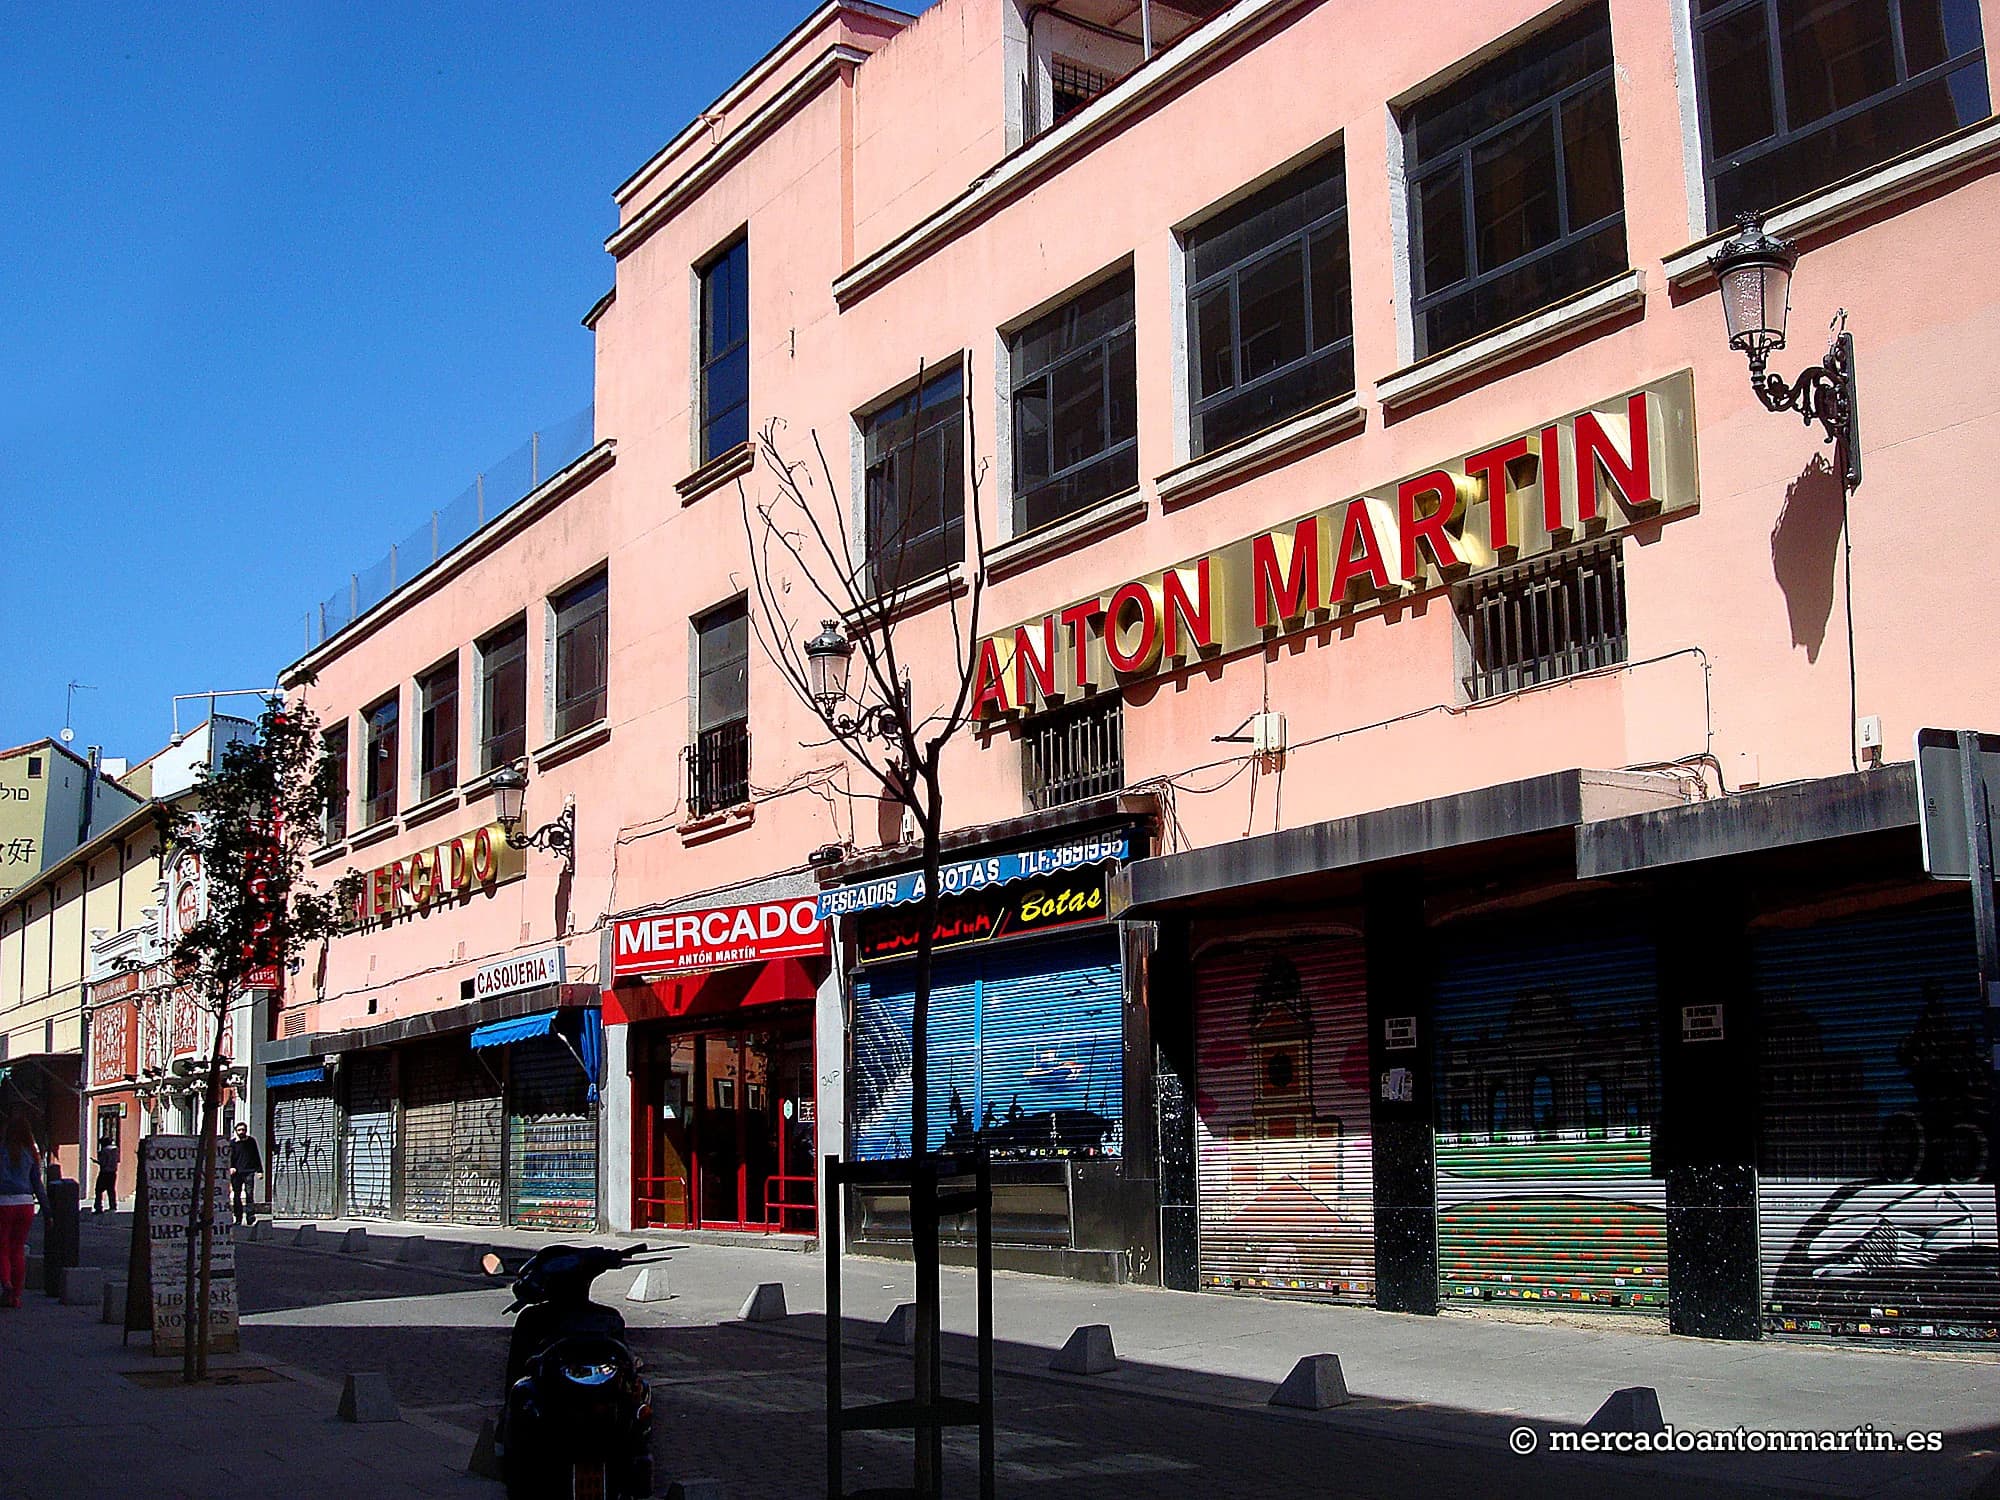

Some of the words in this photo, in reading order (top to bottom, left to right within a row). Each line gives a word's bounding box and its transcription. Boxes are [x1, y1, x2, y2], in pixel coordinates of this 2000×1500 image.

[971, 558, 1212, 721] ANTON
[1253, 391, 1656, 630] MARTIN
[821, 880, 897, 913] PESCADOS
[1020, 887, 1102, 922] Botas
[619, 900, 820, 956] MERCADO
[678, 949, 713, 967] ANTÓN
[715, 945, 757, 963] MARTÍN
[477, 957, 548, 994] CASQUERIA
